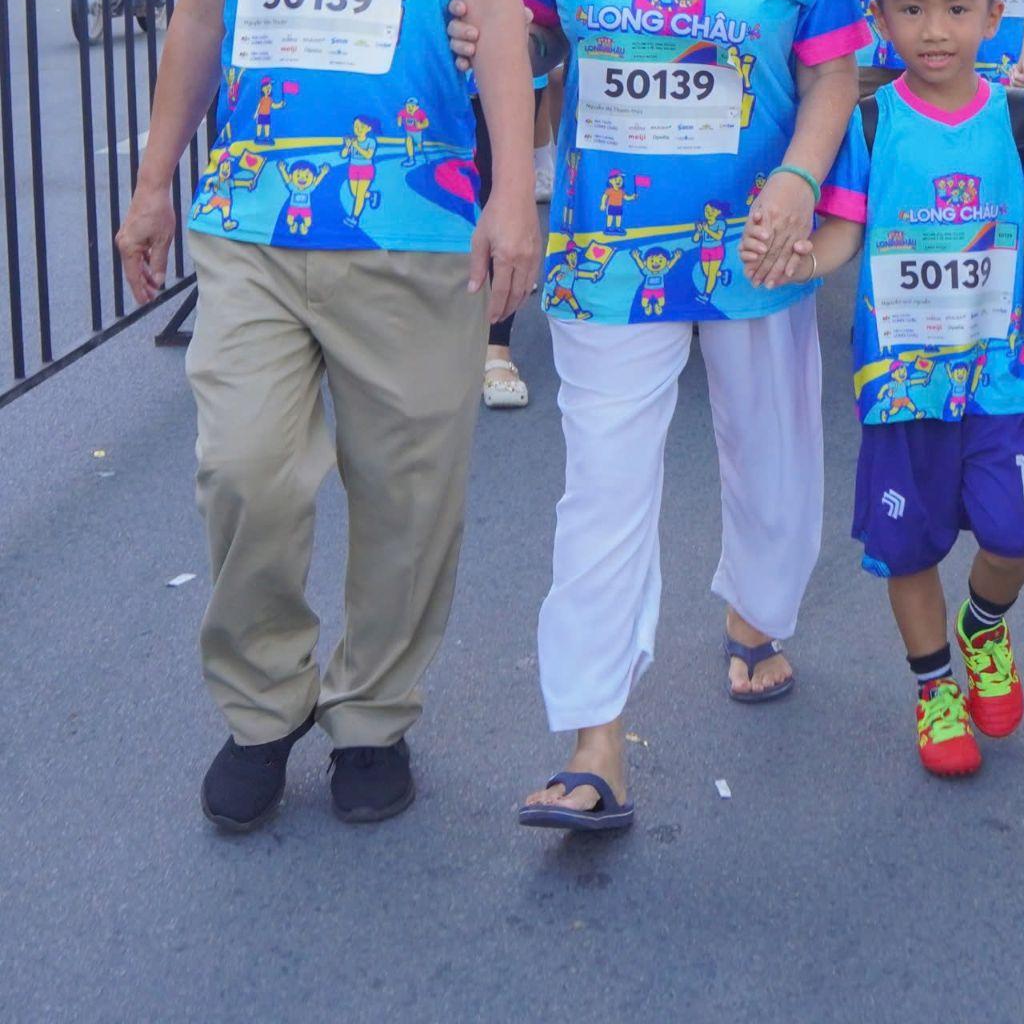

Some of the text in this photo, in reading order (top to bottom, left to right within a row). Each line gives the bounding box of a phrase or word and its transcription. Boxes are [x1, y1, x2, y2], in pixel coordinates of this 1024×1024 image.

[587, 5, 747, 44] LONG CHÂU
[604, 67, 715, 101] 50139
[910, 203, 999, 222] LONG CHÂU
[900, 257, 991, 290] 50139
